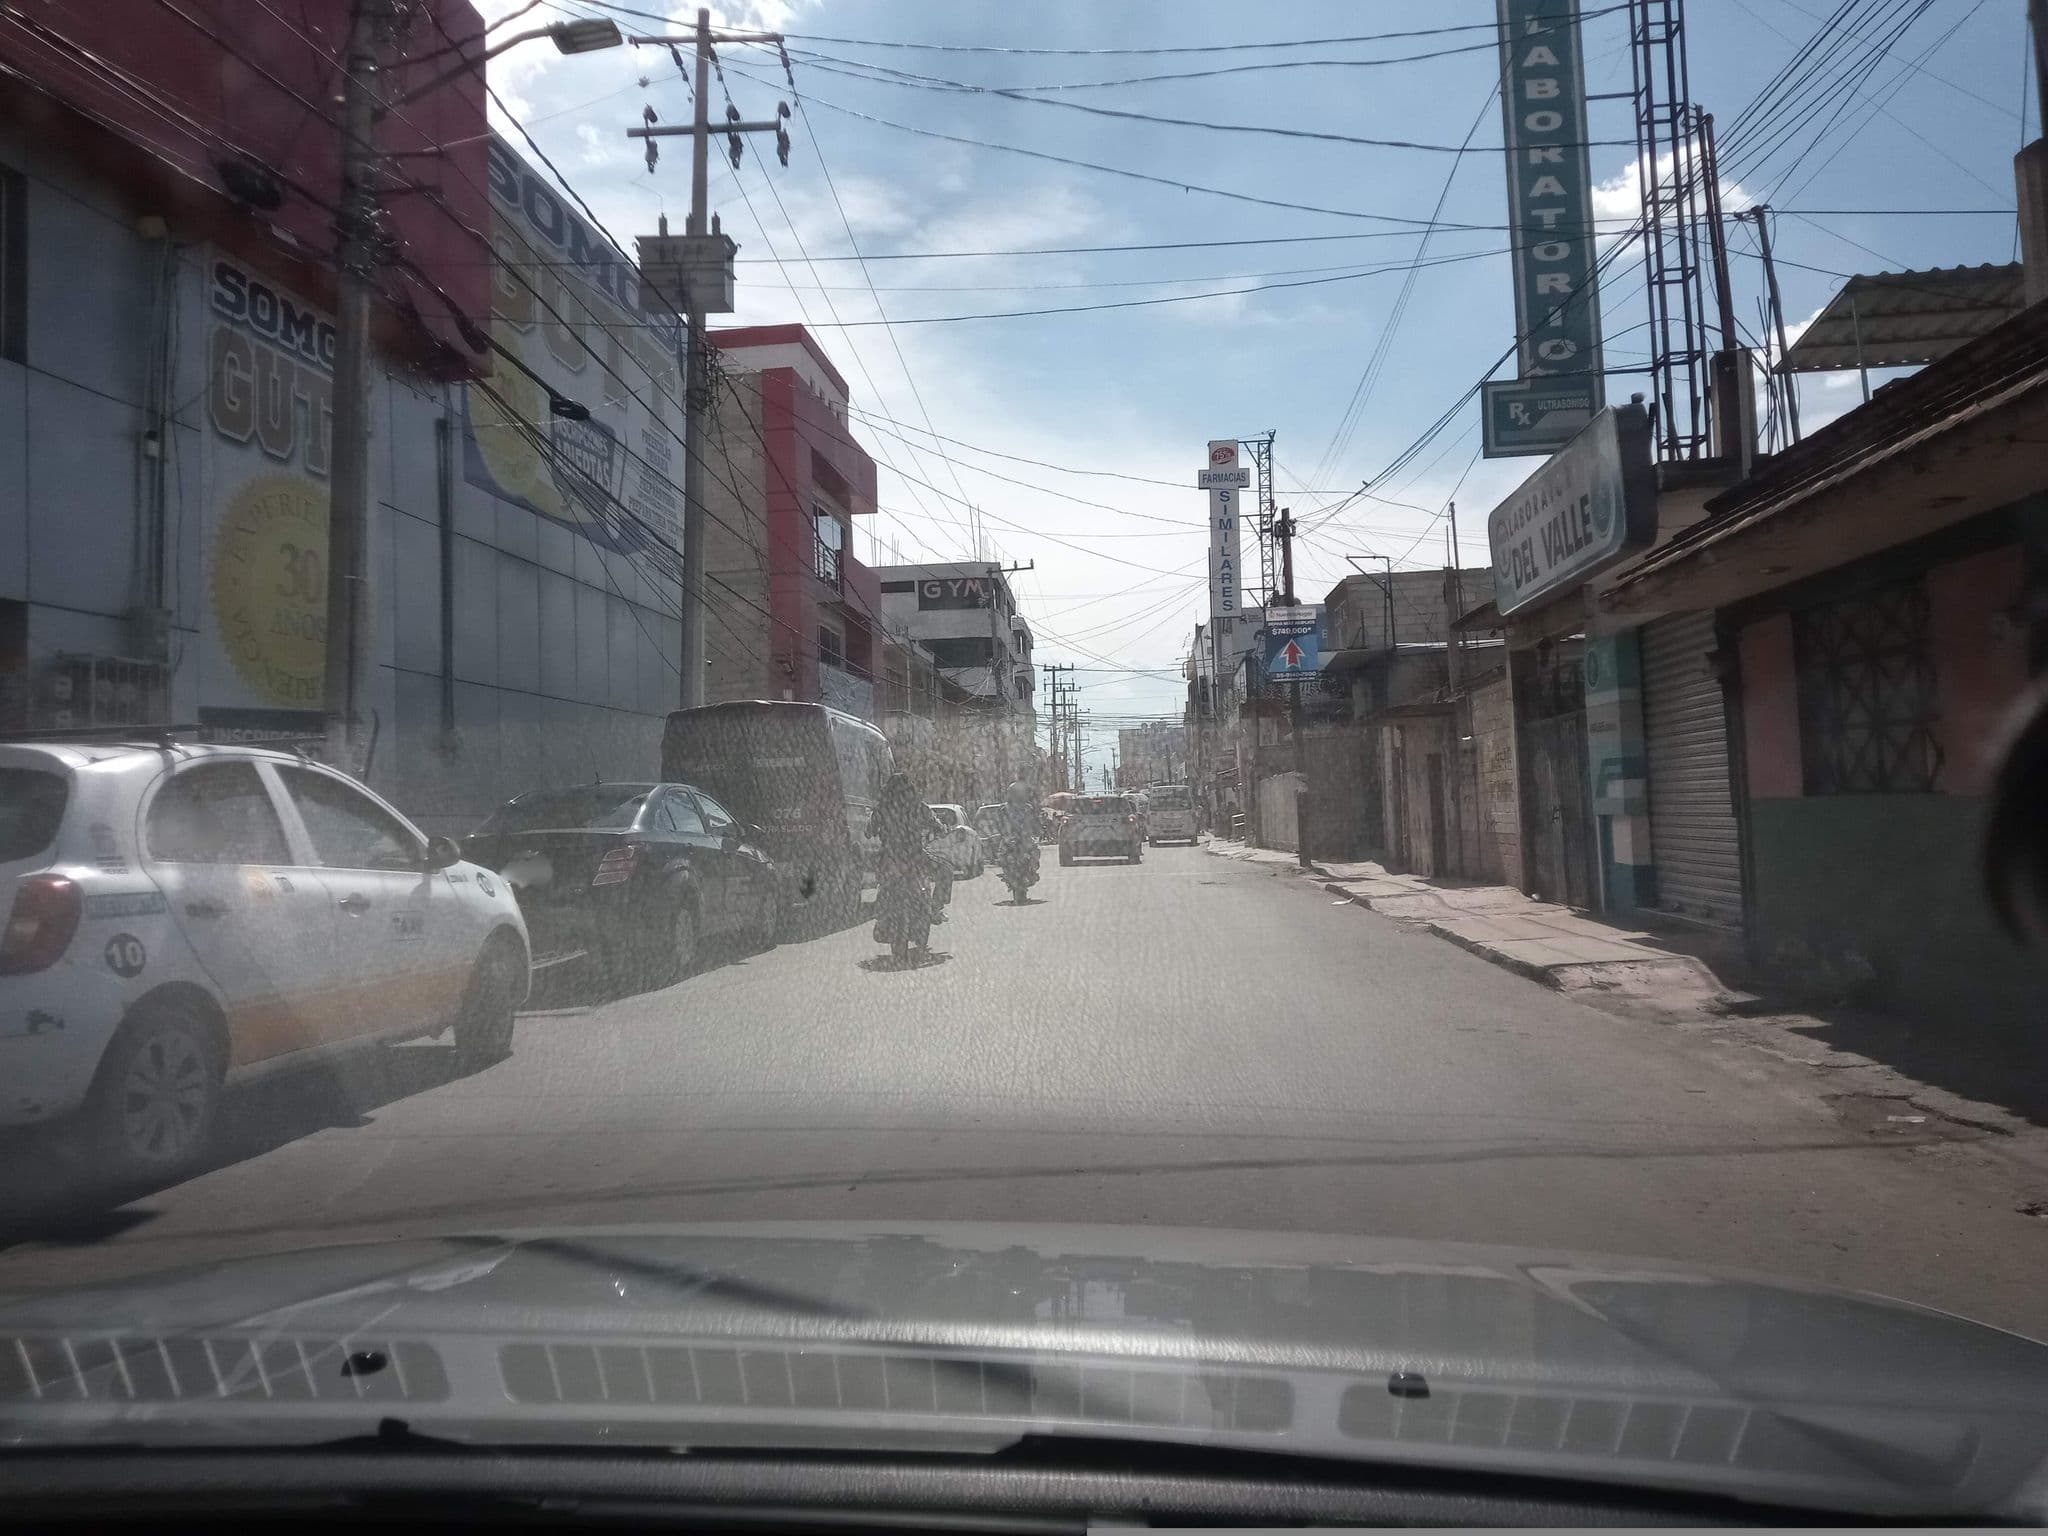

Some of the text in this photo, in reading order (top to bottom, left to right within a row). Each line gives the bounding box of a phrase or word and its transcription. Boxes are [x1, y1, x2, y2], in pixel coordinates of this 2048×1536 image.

[1521, 14, 1578, 361] LABORATORIO
[212, 261, 335, 369] SOMO
[209, 326, 334, 476] GUT
[1202, 472, 1246, 484] FARMACIAS
[276, 542, 322, 604] 30
[923, 579, 984, 599] GYM
[1218, 490, 1233, 612] SIMILARES
[1512, 494, 1594, 590] DEL VALLE
[108, 941, 143, 969] 10
